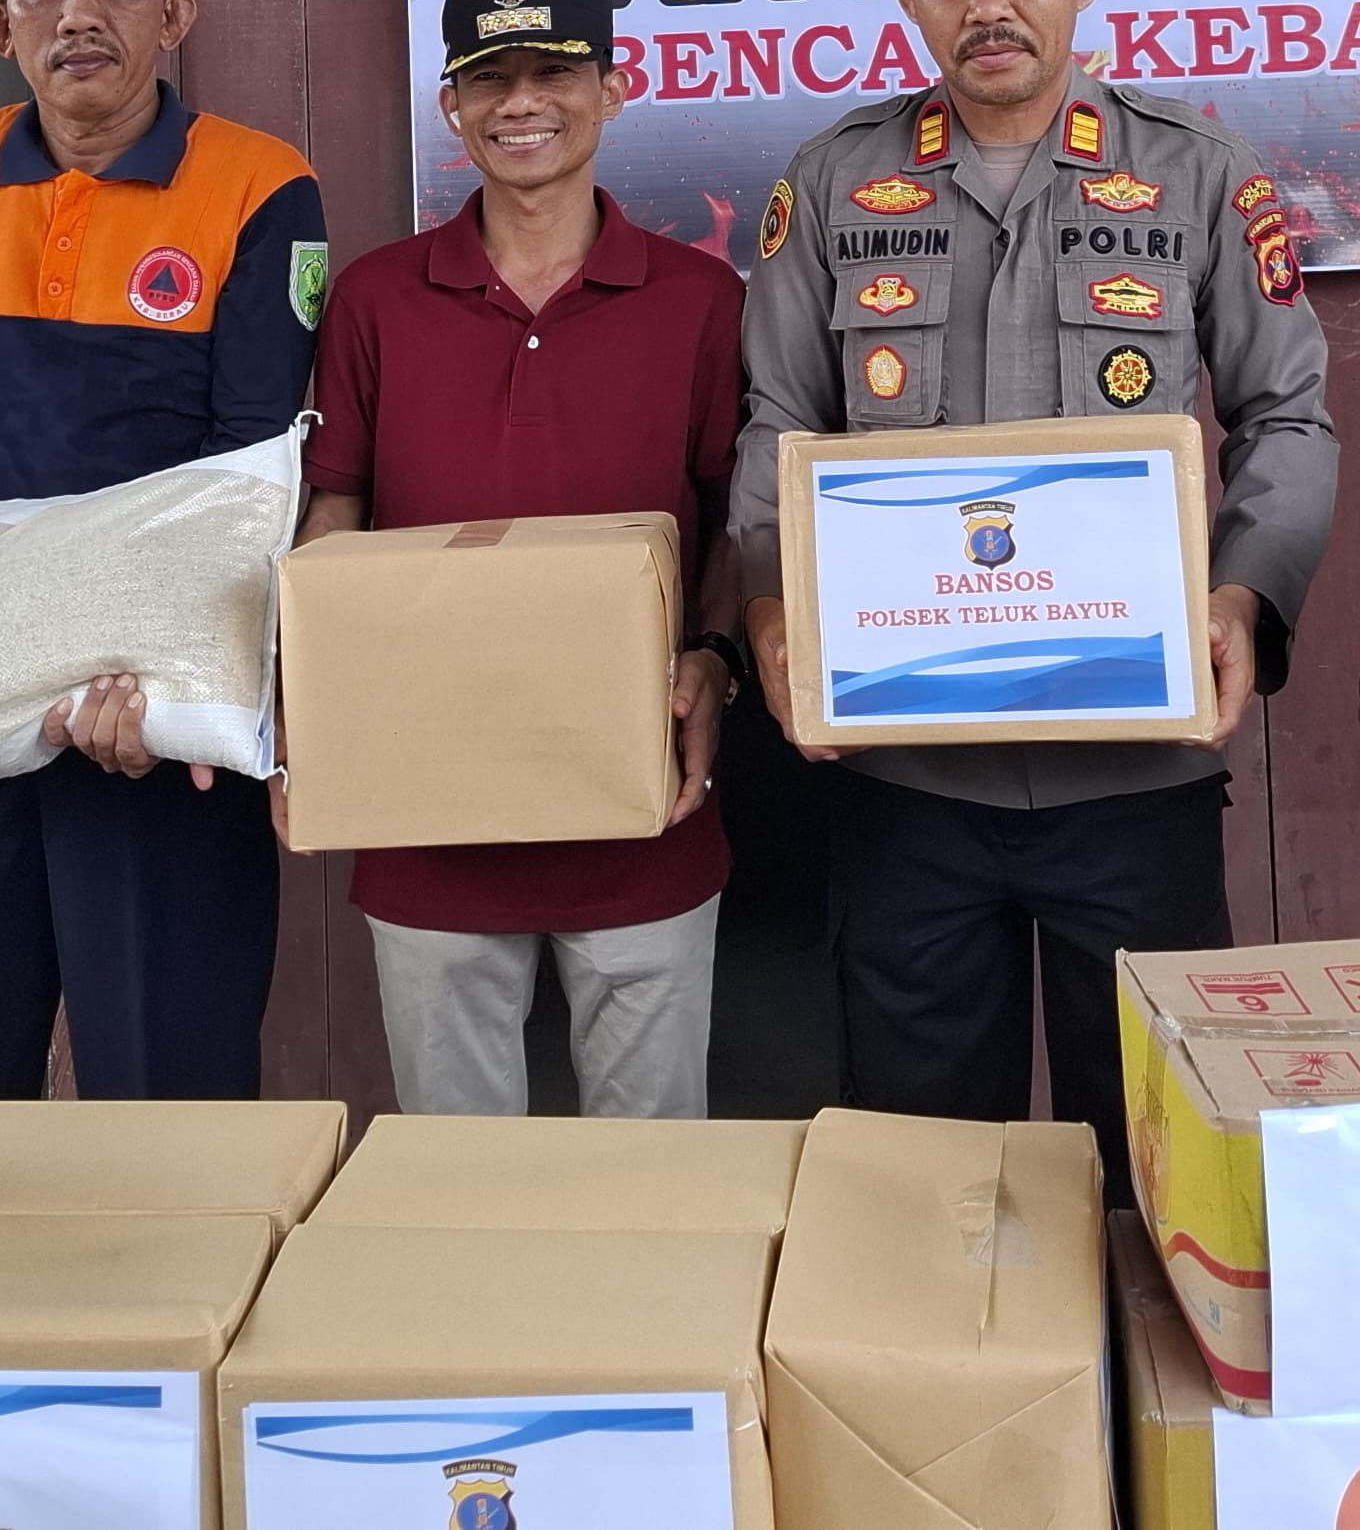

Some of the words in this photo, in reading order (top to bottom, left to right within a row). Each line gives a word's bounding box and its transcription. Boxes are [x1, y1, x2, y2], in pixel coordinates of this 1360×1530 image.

[838, 228, 950, 261] ALIMUDIN
[1060, 225, 1184, 262] POLRI
[935, 569, 1055, 596] BANSOS
[856, 607, 951, 629] POLSEK
[957, 603, 1039, 625] TELUK
[1046, 600, 1130, 622] BAYUR
